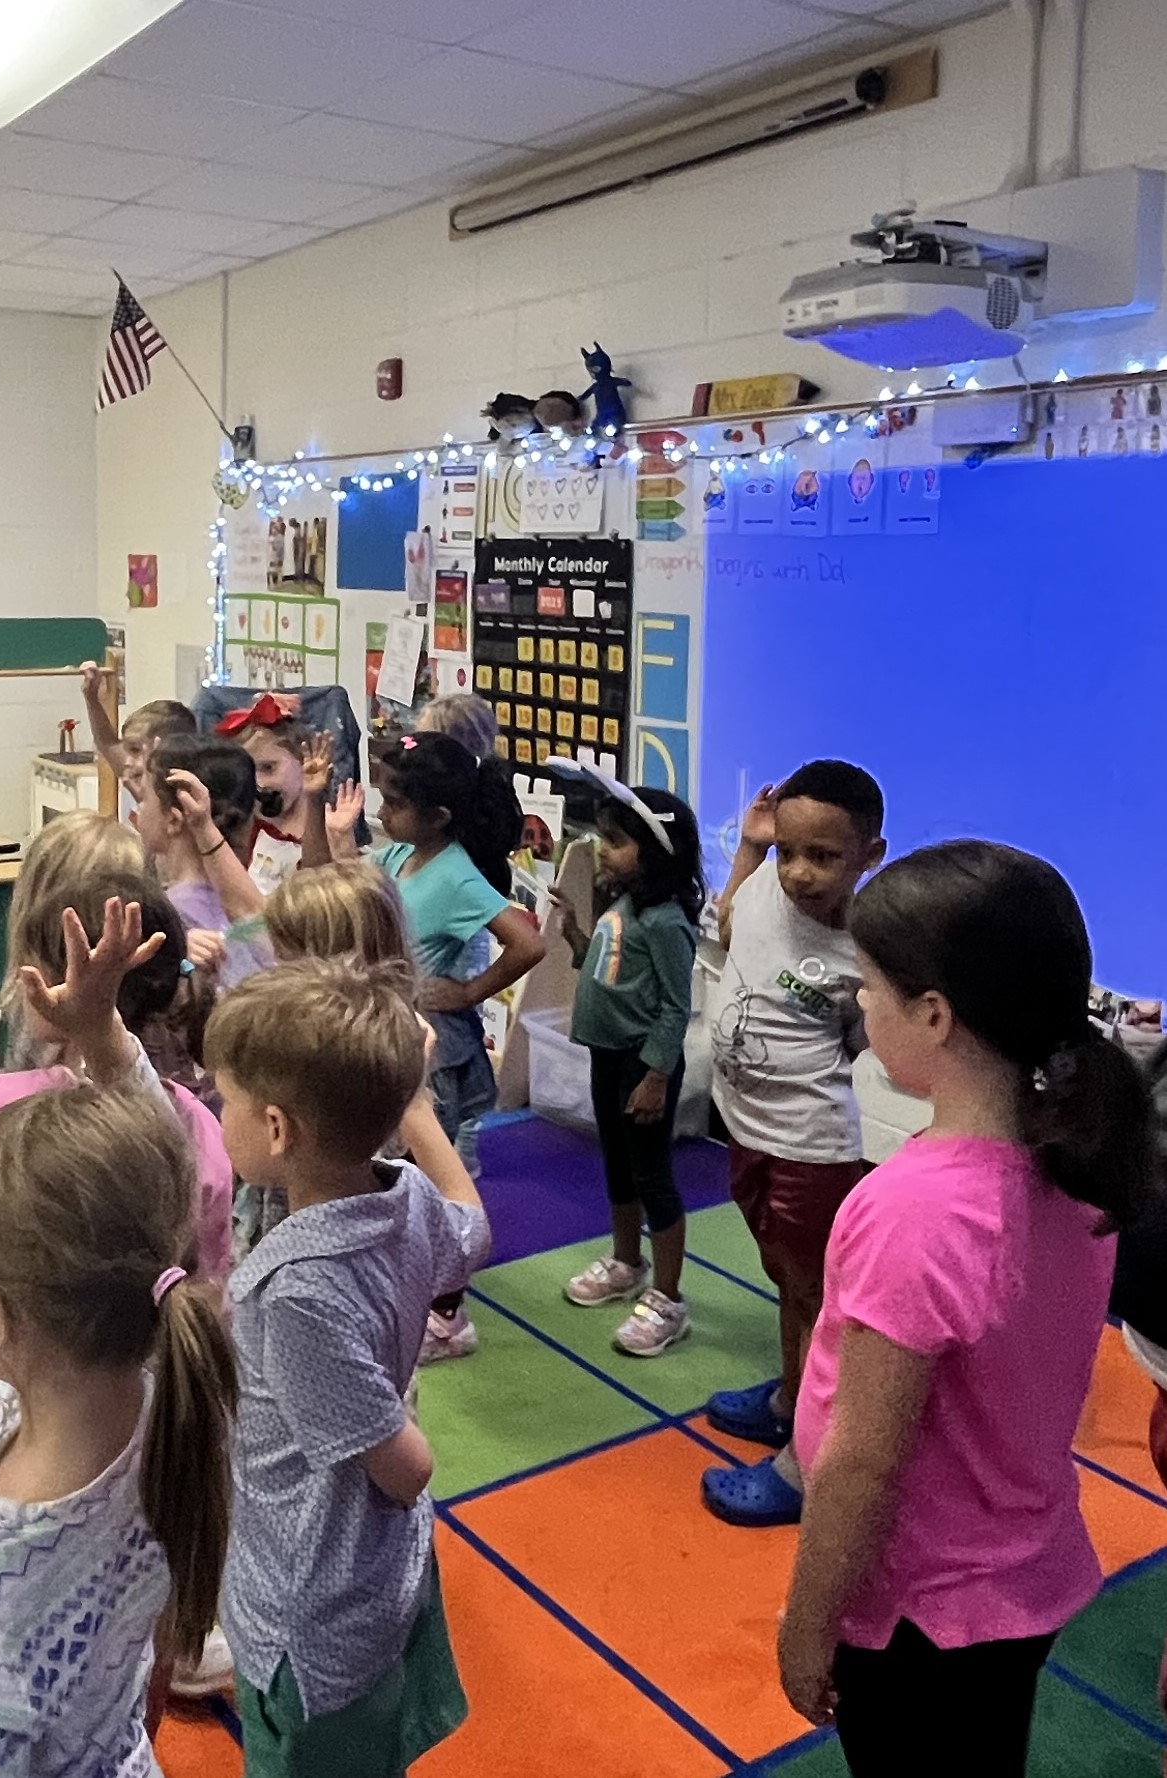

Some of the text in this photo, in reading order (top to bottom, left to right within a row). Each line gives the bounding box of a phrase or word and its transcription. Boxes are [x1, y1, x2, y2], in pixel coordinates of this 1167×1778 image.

[494, 556, 609, 575] Monthly Calendar
[636, 617, 674, 715] F
